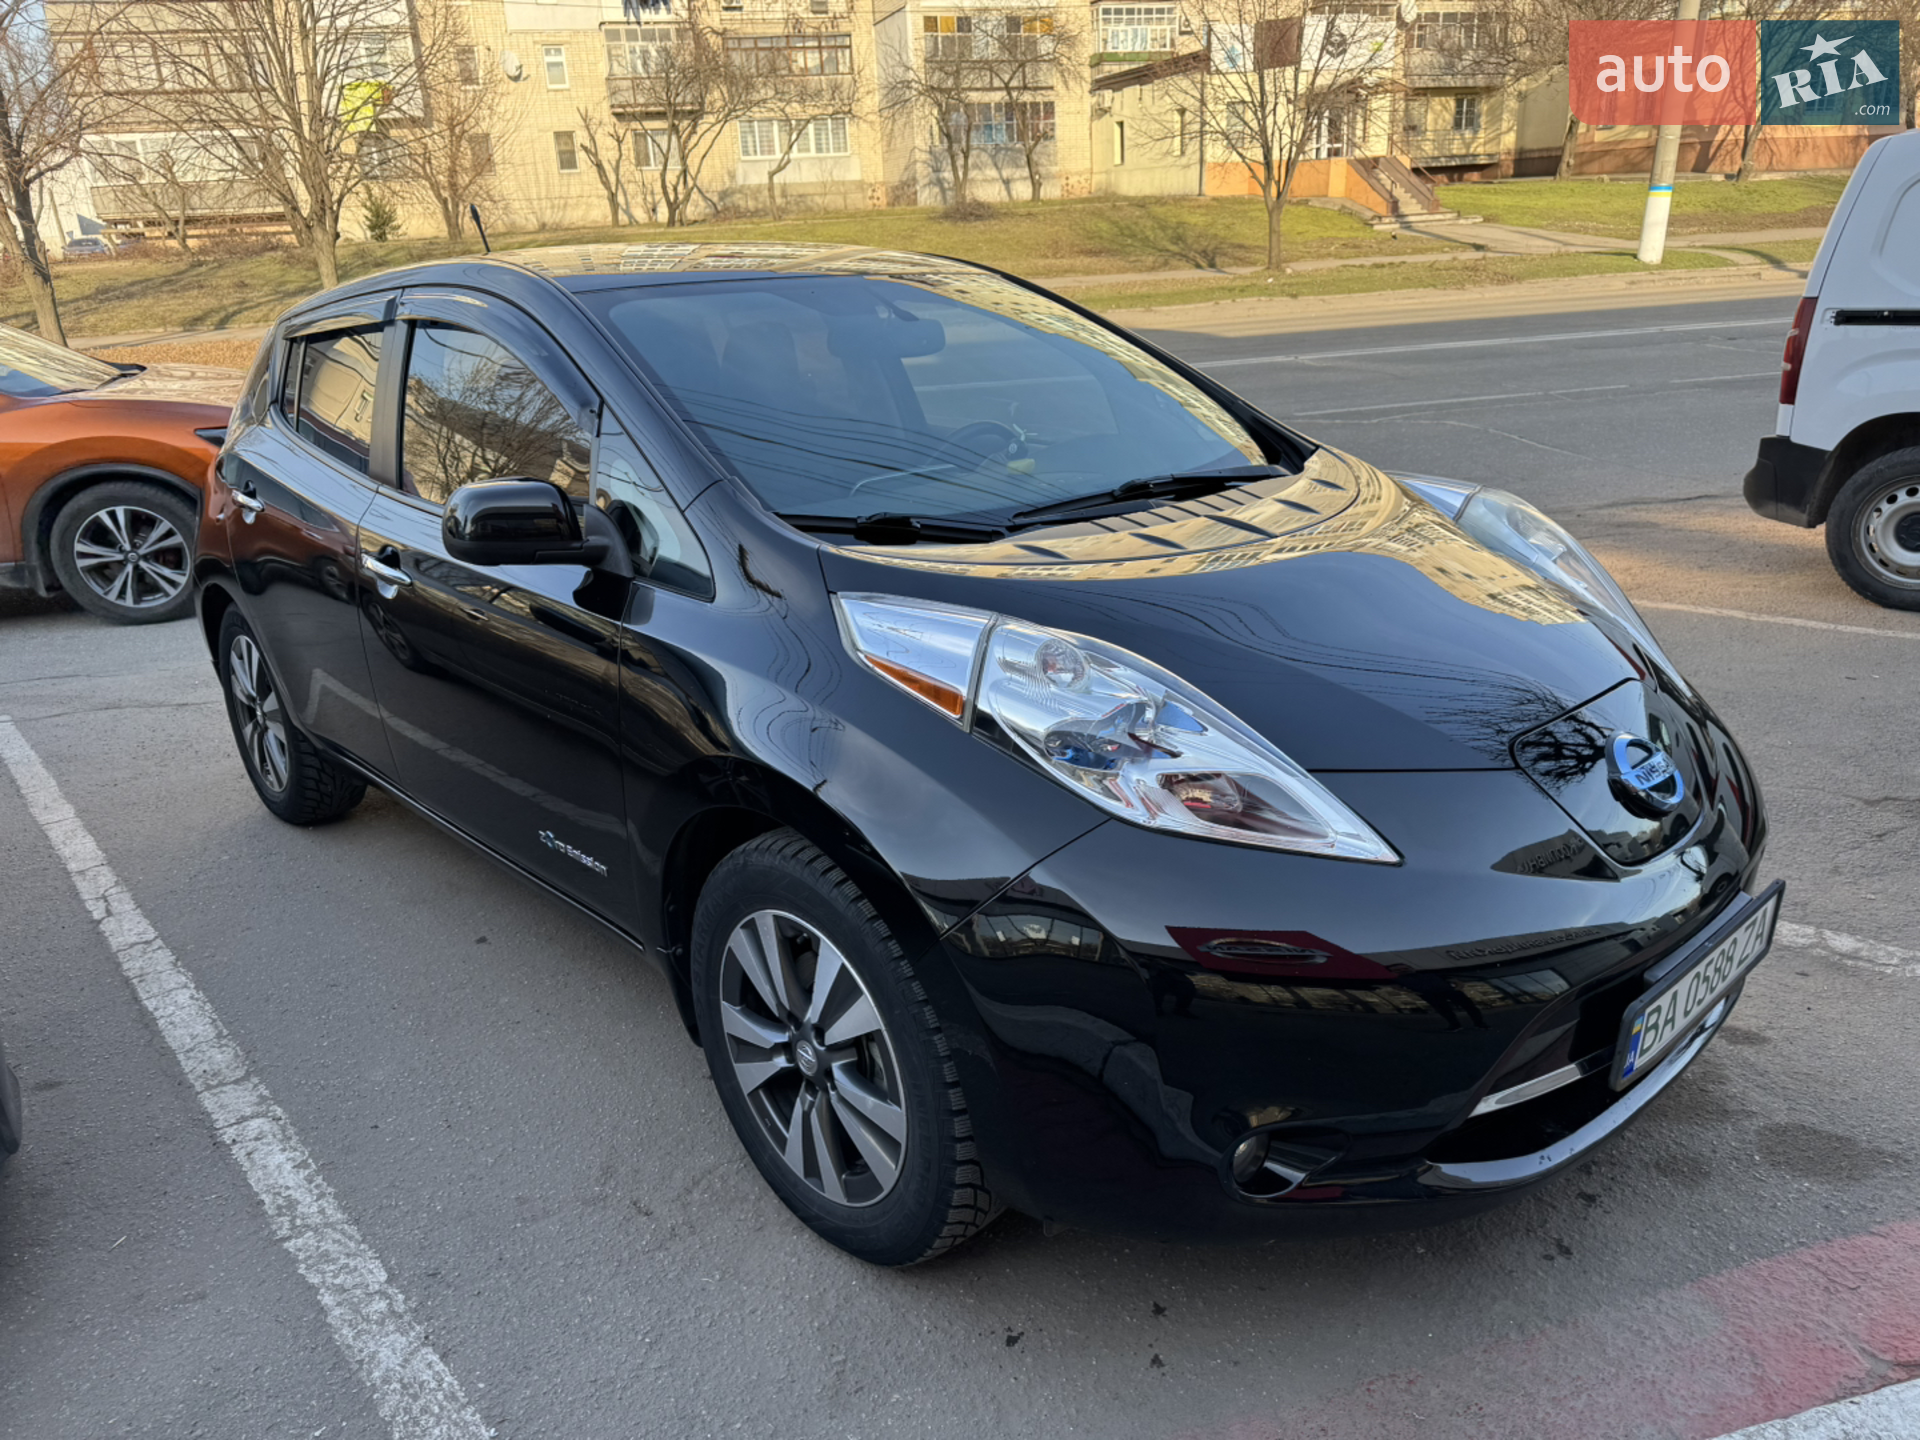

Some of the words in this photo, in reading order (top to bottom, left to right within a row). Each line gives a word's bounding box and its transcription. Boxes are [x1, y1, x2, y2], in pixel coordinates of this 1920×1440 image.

[1638, 989, 1678, 1058] BA
[1683, 936, 1738, 1019] 0588
[1736, 906, 1769, 970] ZA
